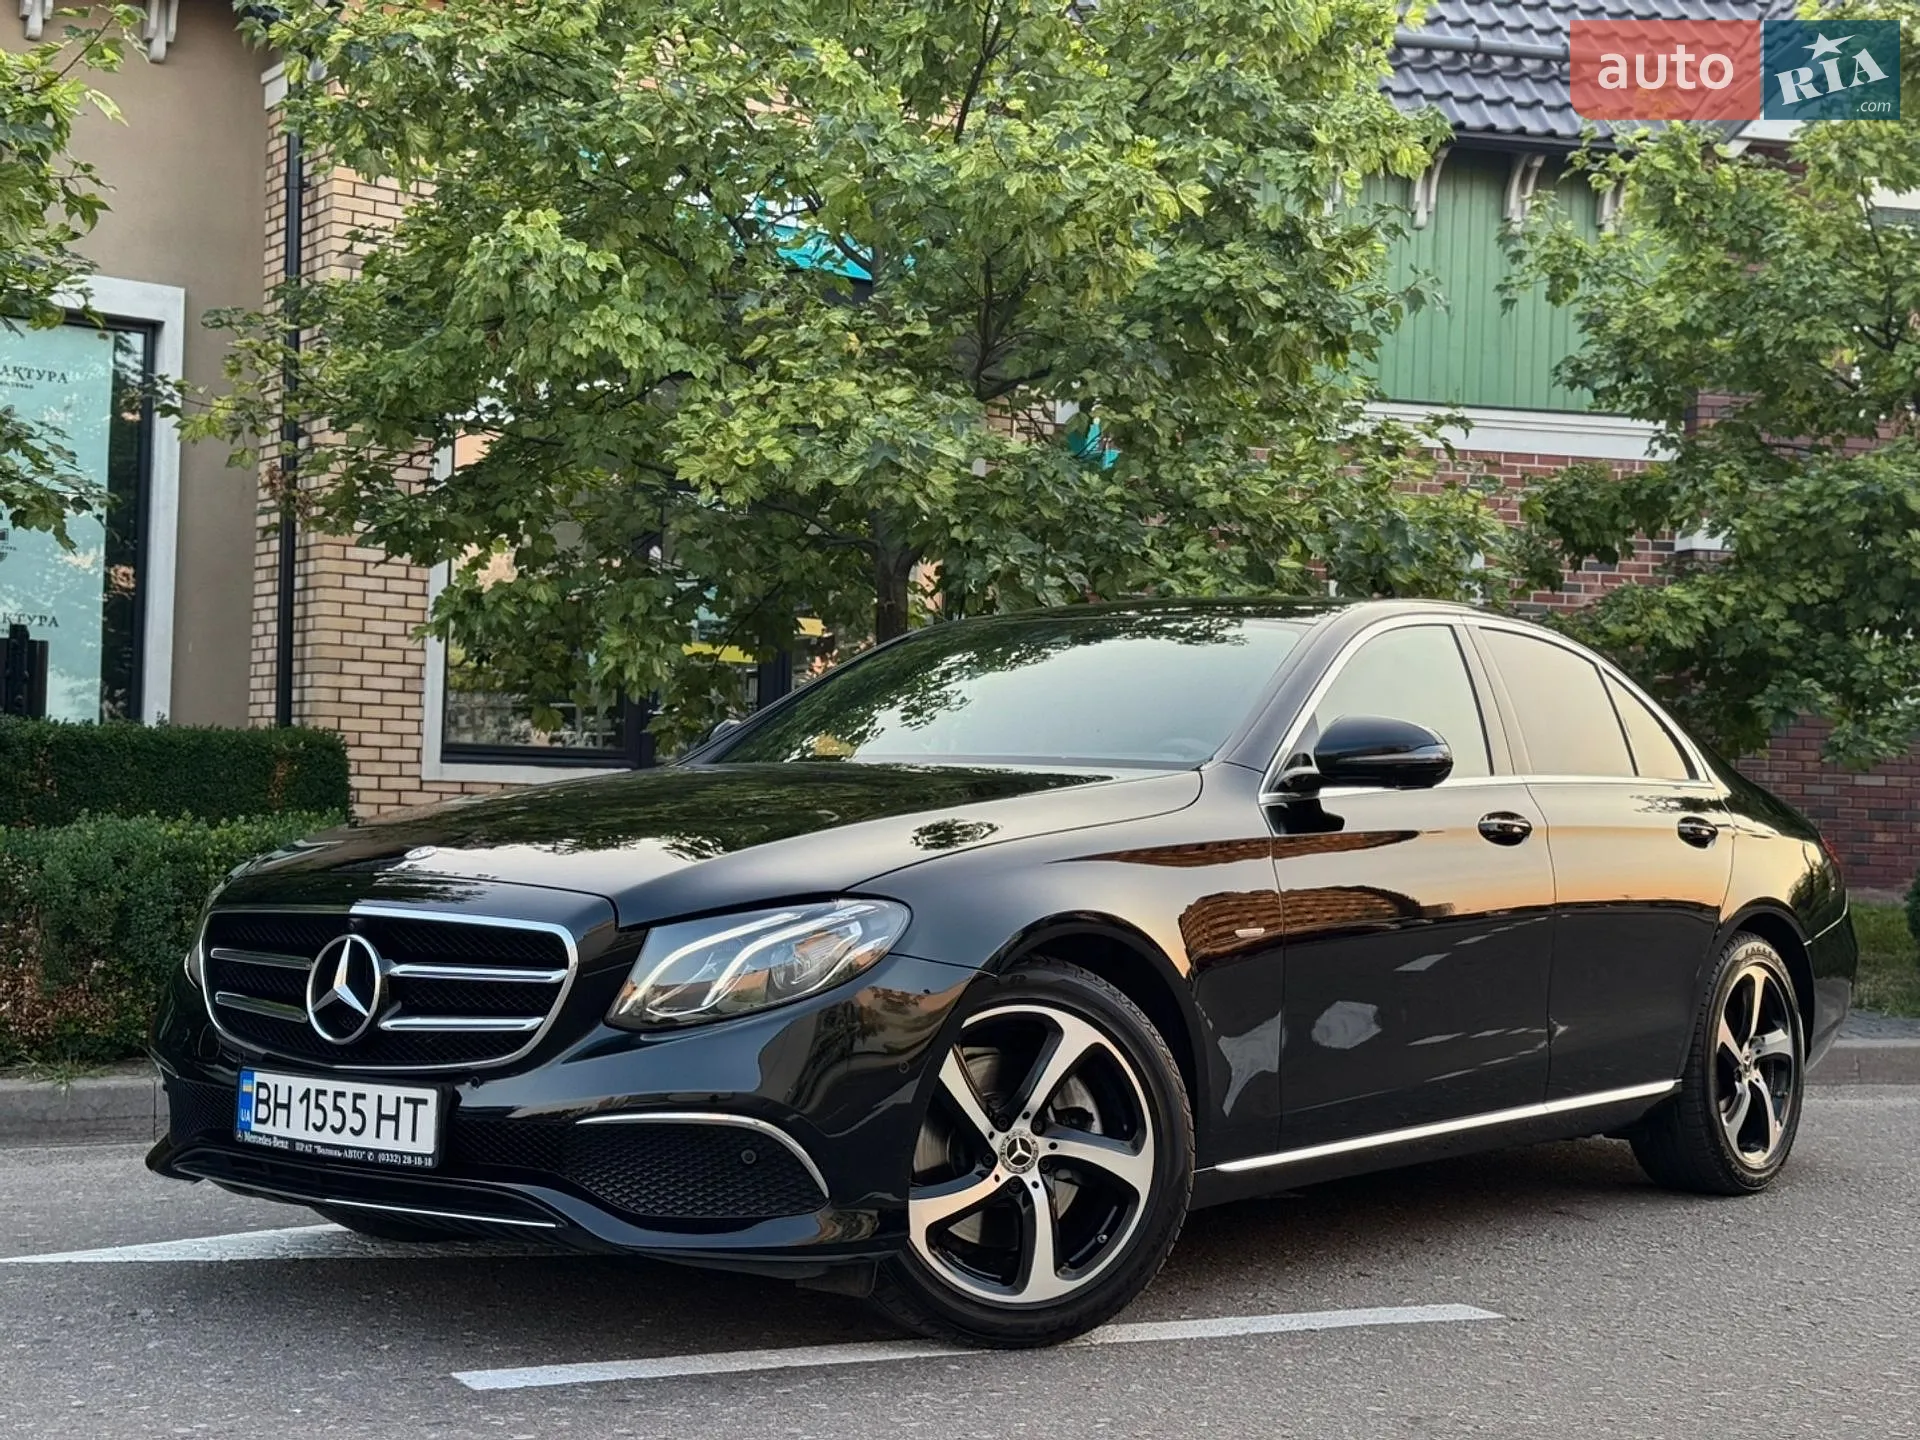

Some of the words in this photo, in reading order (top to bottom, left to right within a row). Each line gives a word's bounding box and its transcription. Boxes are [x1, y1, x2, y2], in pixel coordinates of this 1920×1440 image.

[240, 1109, 251, 1122] UA
[254, 1081, 292, 1129] BH
[298, 1087, 367, 1137] 1555
[375, 1094, 429, 1143] HT
[244, 1130, 289, 1149] Mercedes-Benz
[378, 1151, 401, 1165] (0332)
